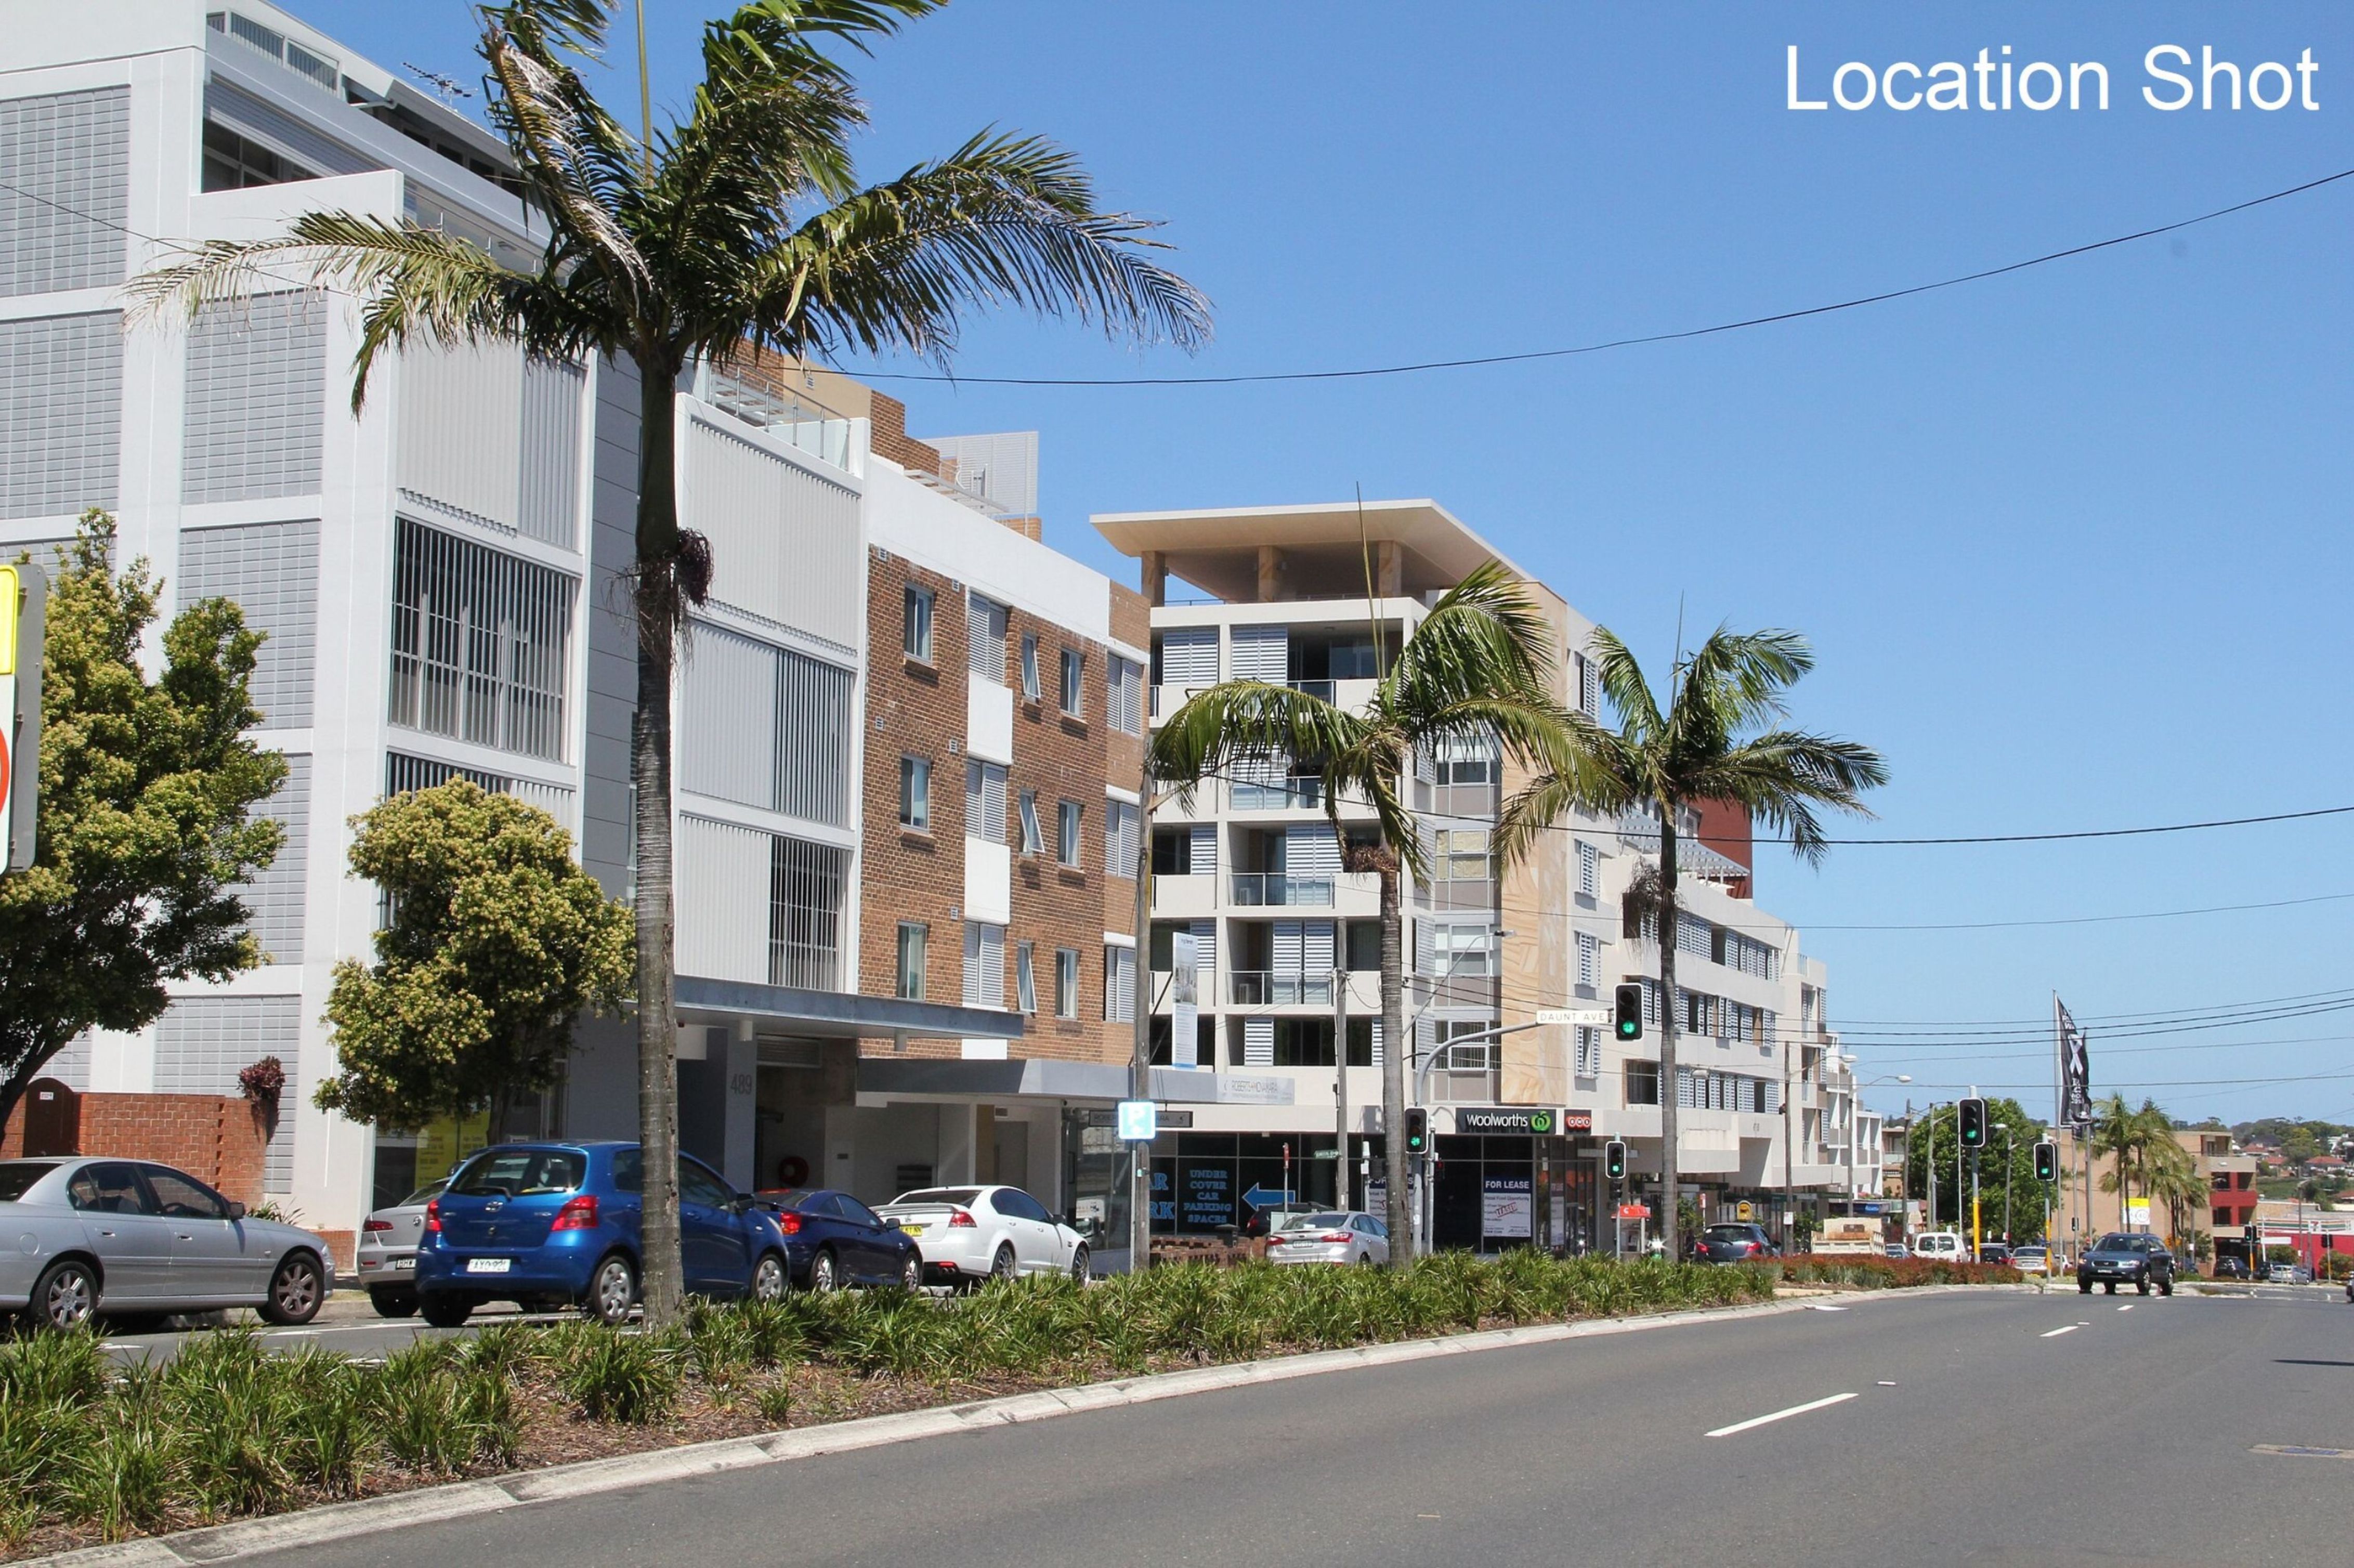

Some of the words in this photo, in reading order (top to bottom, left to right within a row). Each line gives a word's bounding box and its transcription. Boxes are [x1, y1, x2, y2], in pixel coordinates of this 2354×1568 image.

[1540, 1013, 1576, 1021] DAUNT
[1584, 1013, 1605, 1021] AVE
[730, 1074, 752, 1095] 489
[1189, 1170, 1227, 1178] UNDER
[1189, 1181, 1227, 1190] COVER
[1503, 1181, 1529, 1189] LEASE
[1196, 1192, 1219, 1200] CAR
[1183, 1203, 1232, 1212] PARKING
[1187, 1214, 1227, 1223] SPACES
